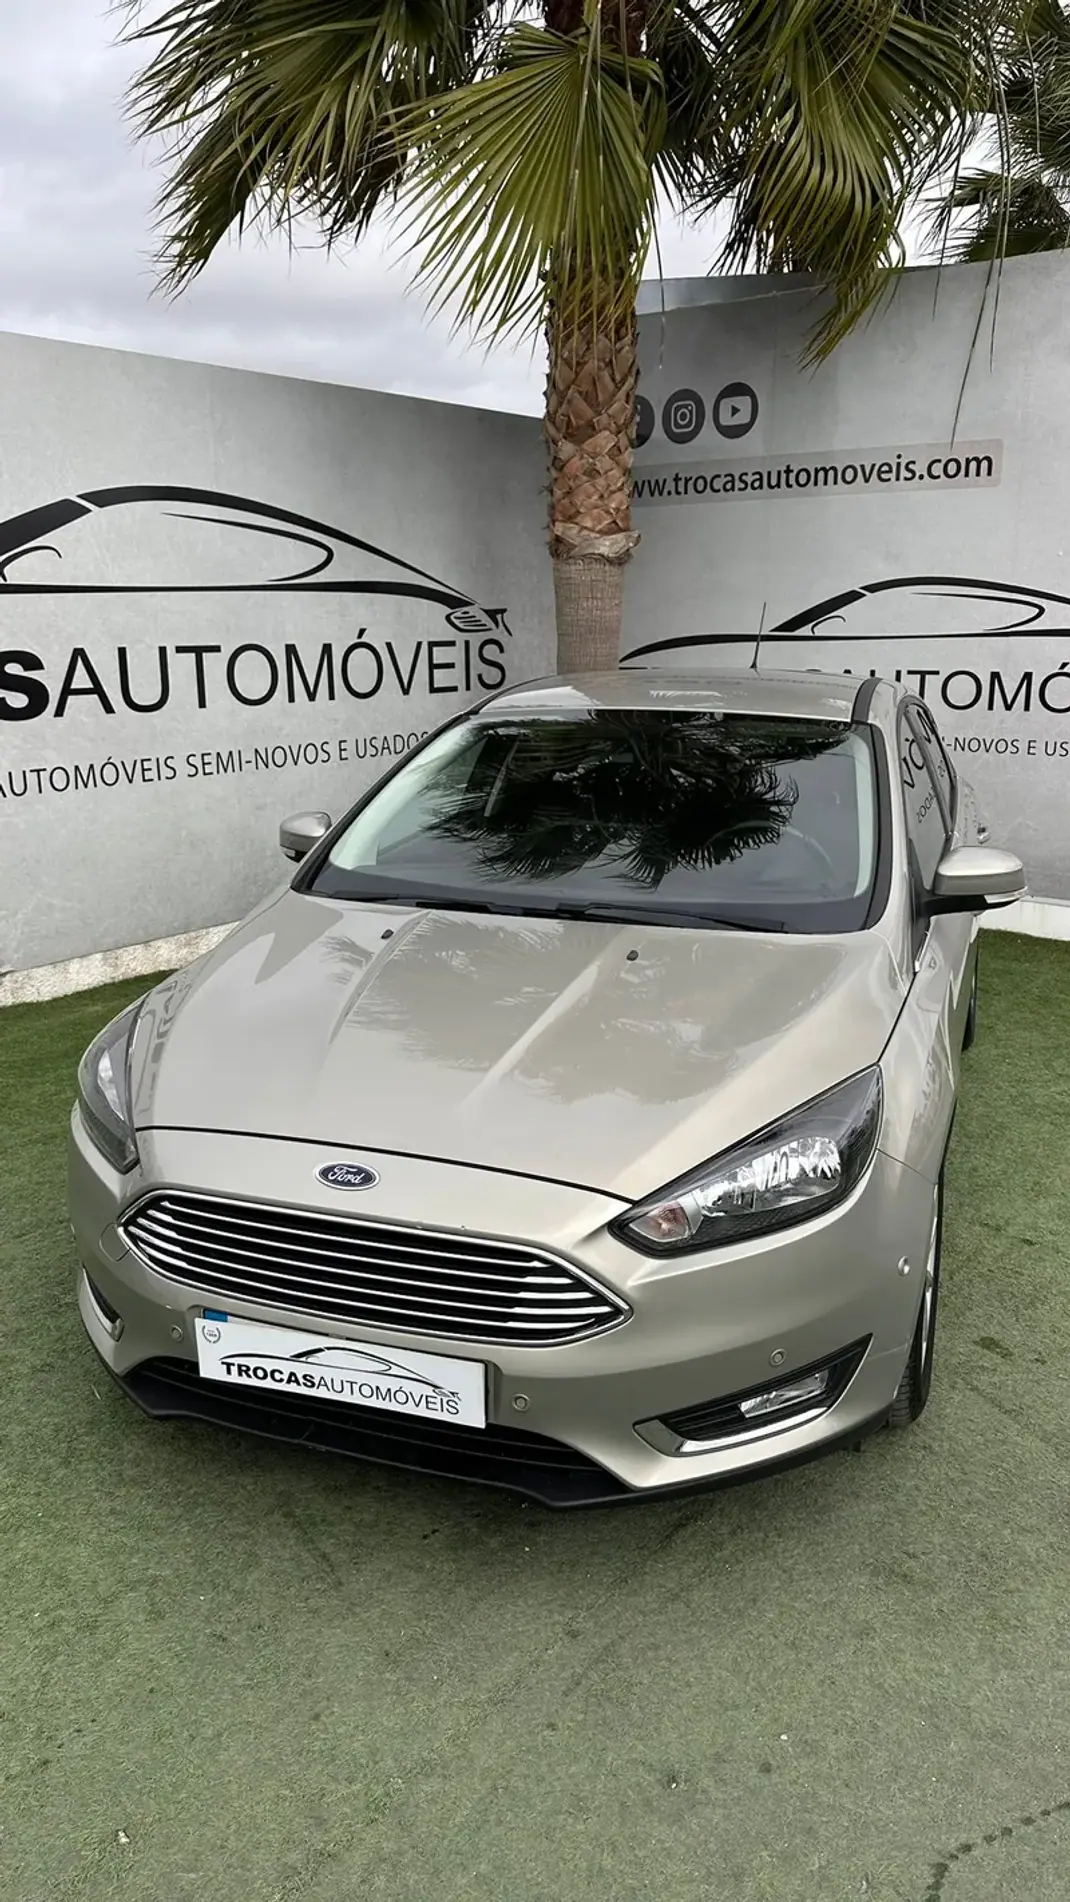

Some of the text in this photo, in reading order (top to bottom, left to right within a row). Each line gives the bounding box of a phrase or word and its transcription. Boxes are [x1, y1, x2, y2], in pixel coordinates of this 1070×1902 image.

[632, 453, 993, 498] ww.trocasautomoveis.com
[186, 741, 331, 778] SEMI-NOVOS
[338, 739, 349, 761] E
[942, 736, 1070, 757] -NOVOS E US
[328, 1165, 365, 1184] Ford
